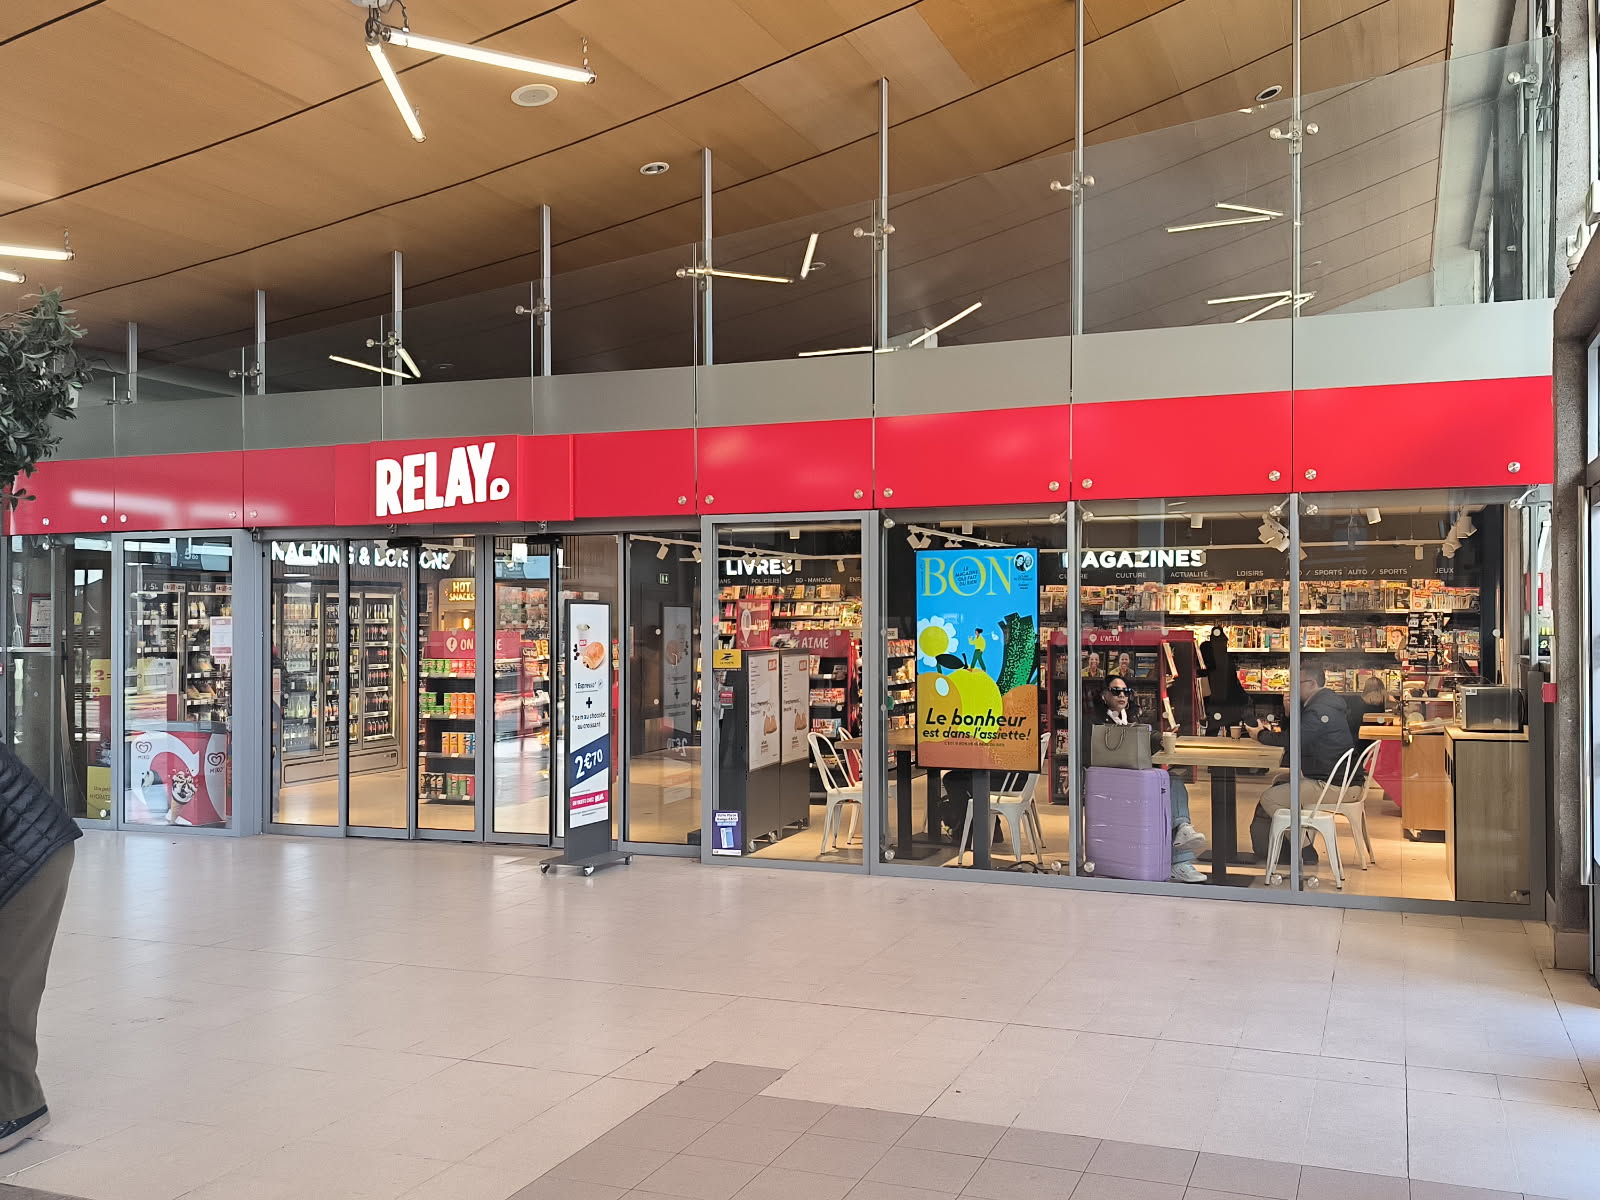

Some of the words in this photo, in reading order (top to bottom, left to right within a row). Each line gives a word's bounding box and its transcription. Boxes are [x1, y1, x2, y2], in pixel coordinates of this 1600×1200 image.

[376, 442, 496, 517] RELAY
[359, 546, 371, 566] &
[374, 548, 453, 571] BOISONS
[921, 556, 1014, 597] BON
[1170, 570, 1209, 578] ACTUALITÉ
[448, 592, 475, 601] SNACKS
[452, 582, 472, 593] HOT
[801, 637, 830, 650] AIME
[925, 707, 947, 725] Le
[951, 708, 1027, 728] bonheur
[922, 728, 940, 738] est
[943, 726, 970, 739] dans
[974, 727, 1032, 741] l'assiette!
[575, 748, 603, 779] 2€70
